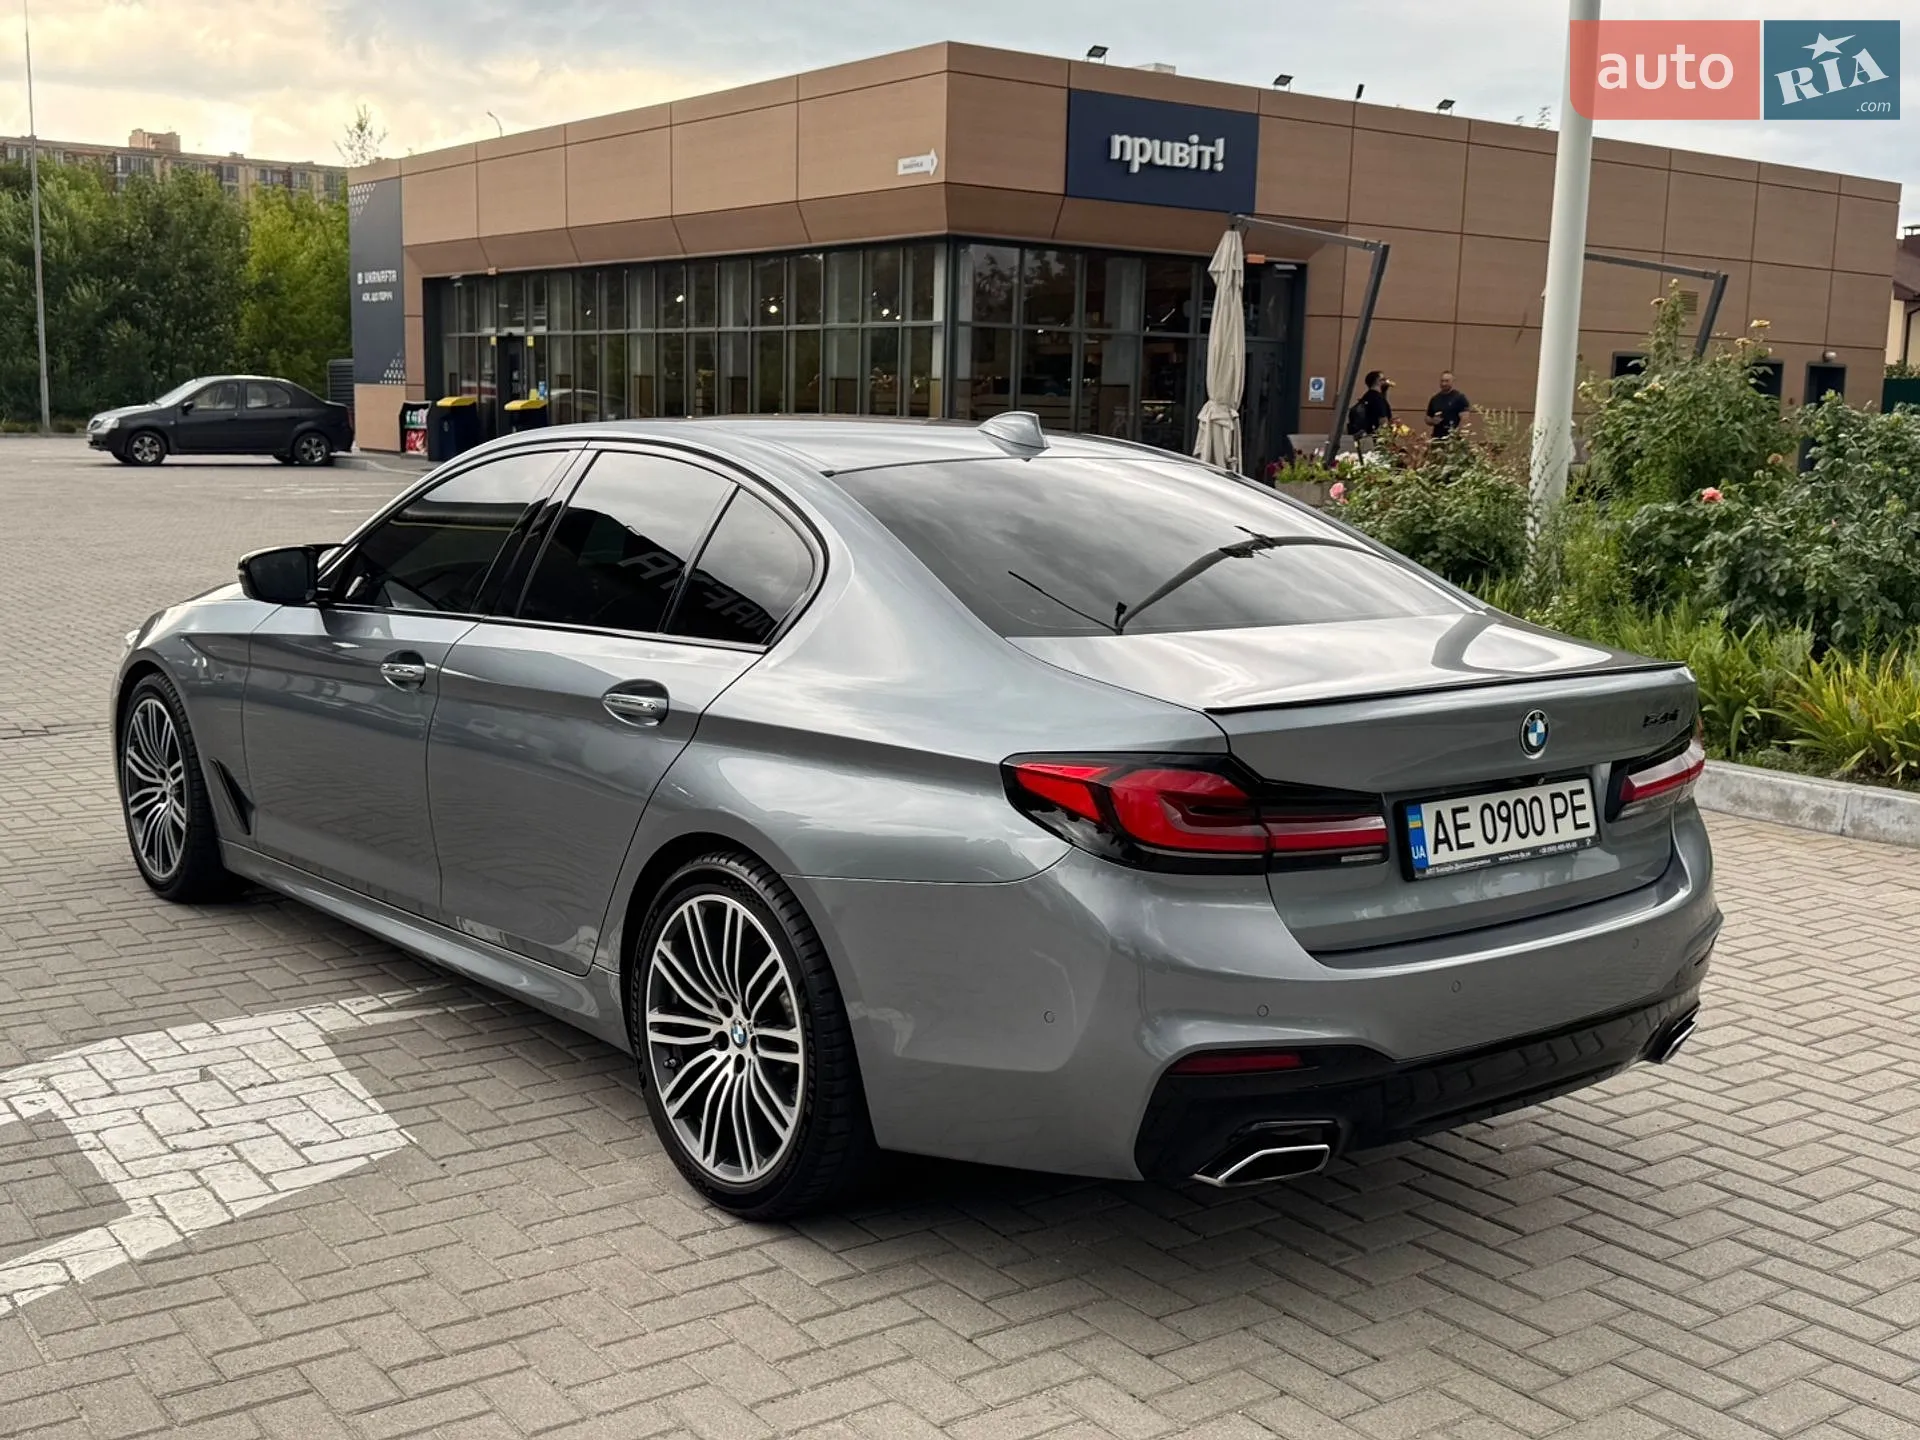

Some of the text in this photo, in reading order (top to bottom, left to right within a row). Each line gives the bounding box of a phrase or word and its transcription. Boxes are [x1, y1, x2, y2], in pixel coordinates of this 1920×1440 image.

[1110, 134, 1225, 174] привіт!
[1433, 788, 1591, 855] AE 0900 PE
[1411, 845, 1427, 860] UA
